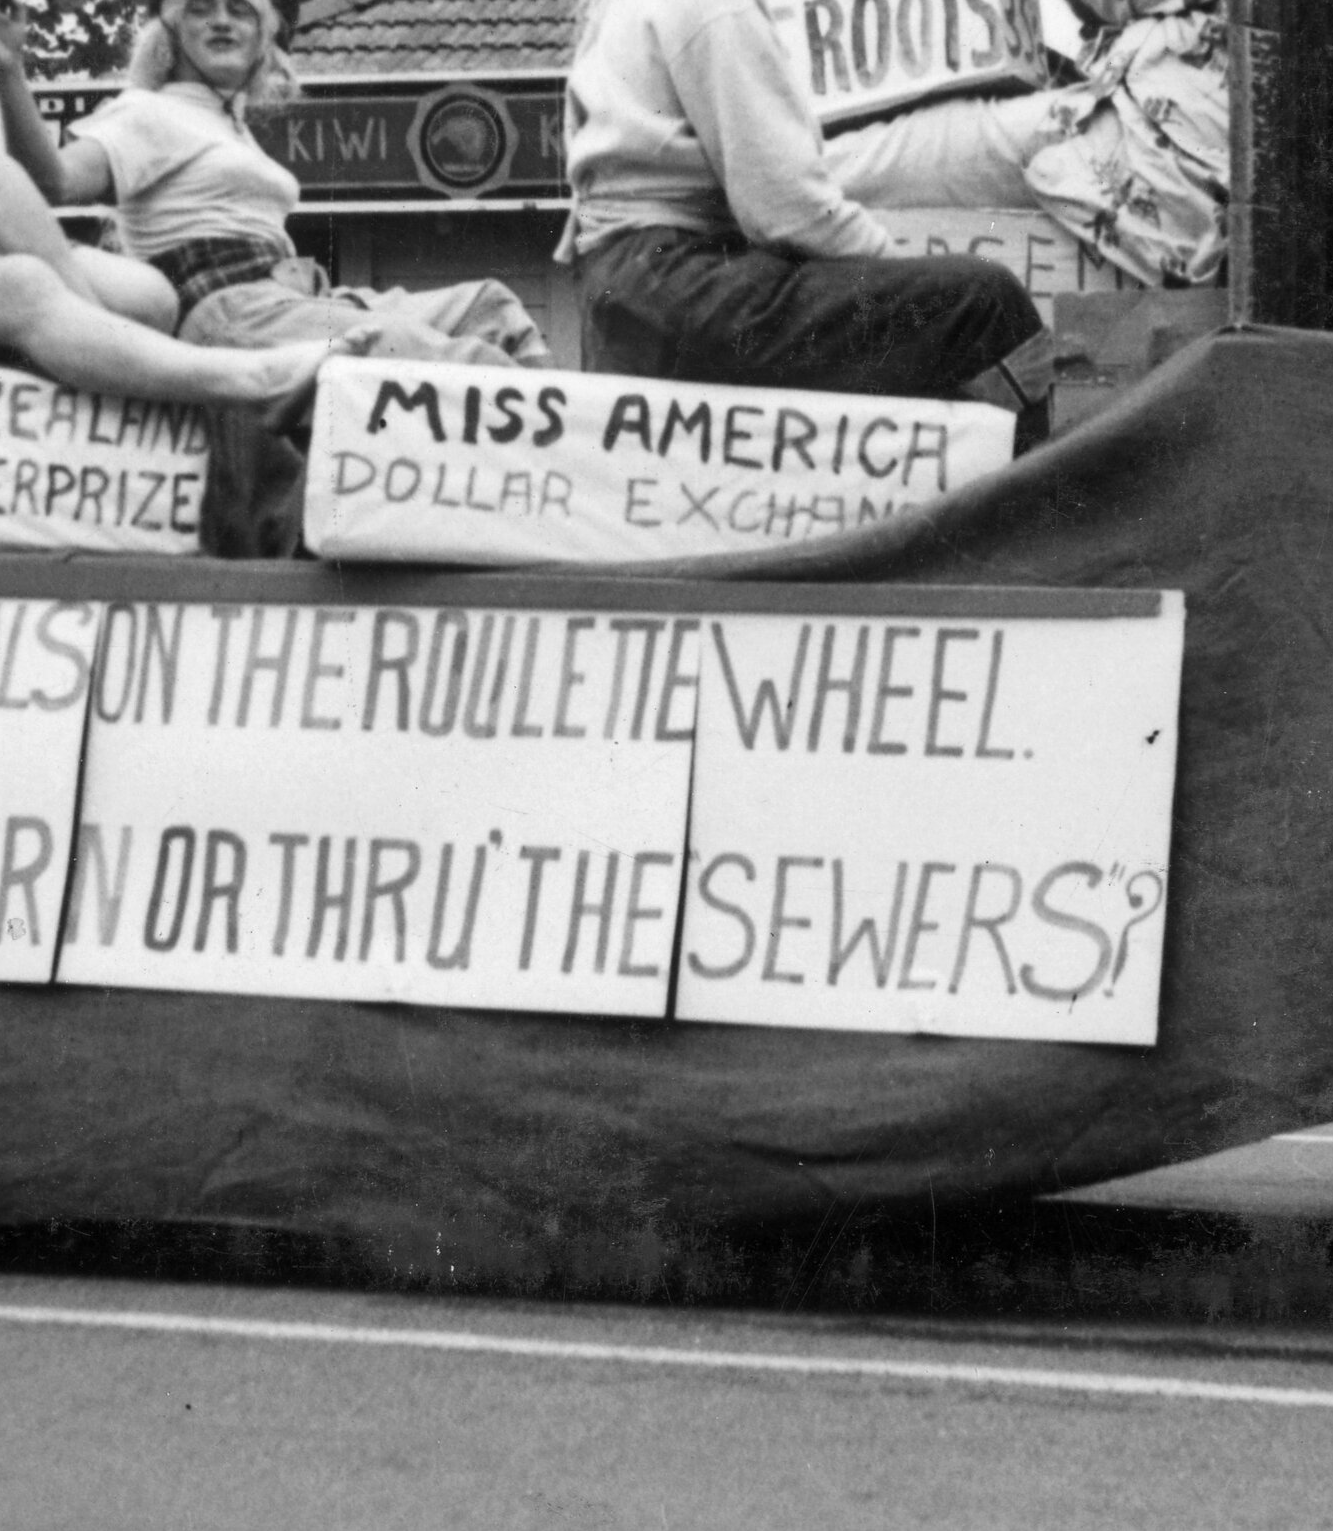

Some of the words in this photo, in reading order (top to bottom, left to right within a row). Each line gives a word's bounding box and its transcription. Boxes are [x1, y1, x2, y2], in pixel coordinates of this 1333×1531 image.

[287, 116, 387, 162] KIWI
[331, 451, 574, 518] DOLLAR
[367, 379, 568, 448] MISS
[603, 393, 948, 493] AMERICA
[94, 601, 186, 724] ON
[207, 603, 357, 731] THE
[361, 609, 701, 744] ROULETTE
[710, 620, 1035, 761] WHEEL.
[144, 824, 249, 954] OR
[517, 844, 675, 979] THE
